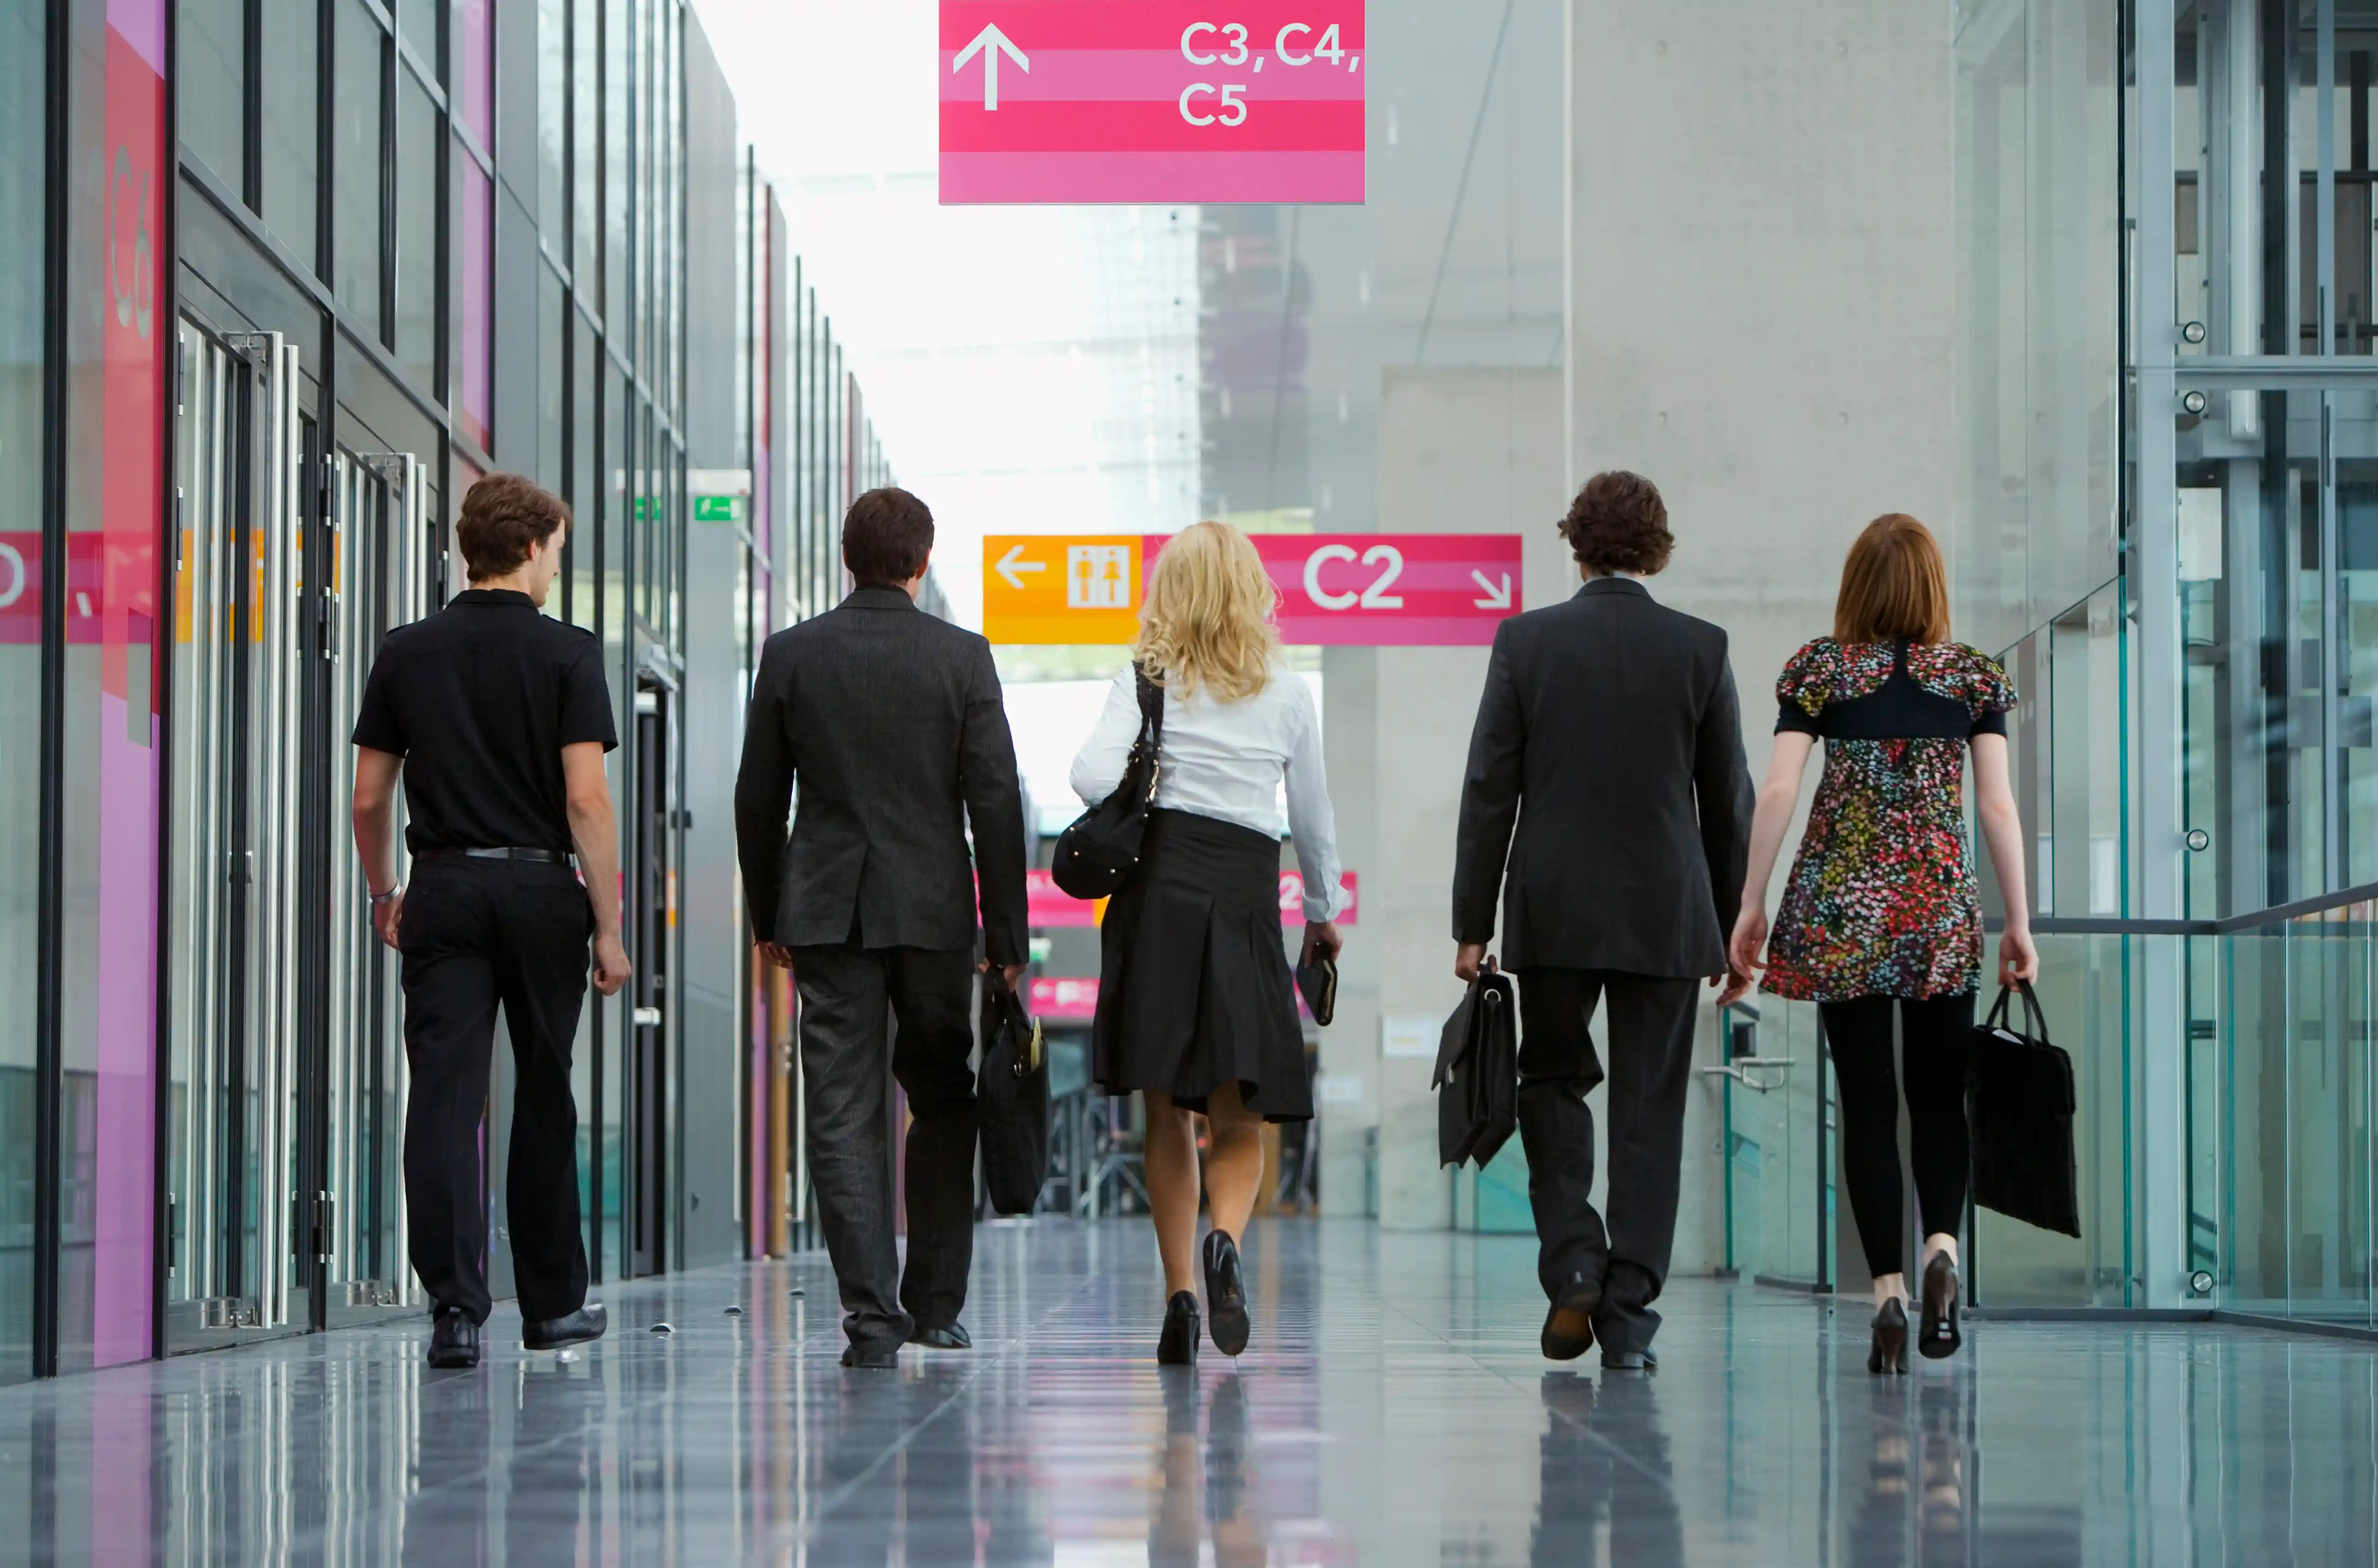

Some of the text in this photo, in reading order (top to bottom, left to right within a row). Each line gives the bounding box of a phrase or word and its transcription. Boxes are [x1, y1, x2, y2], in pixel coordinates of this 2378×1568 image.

[1180, 22, 1360, 73] C3, C4,
[1179, 83, 1247, 126] C5
[111, 144, 153, 340] C6
[1303, 544, 1403, 610] C2
